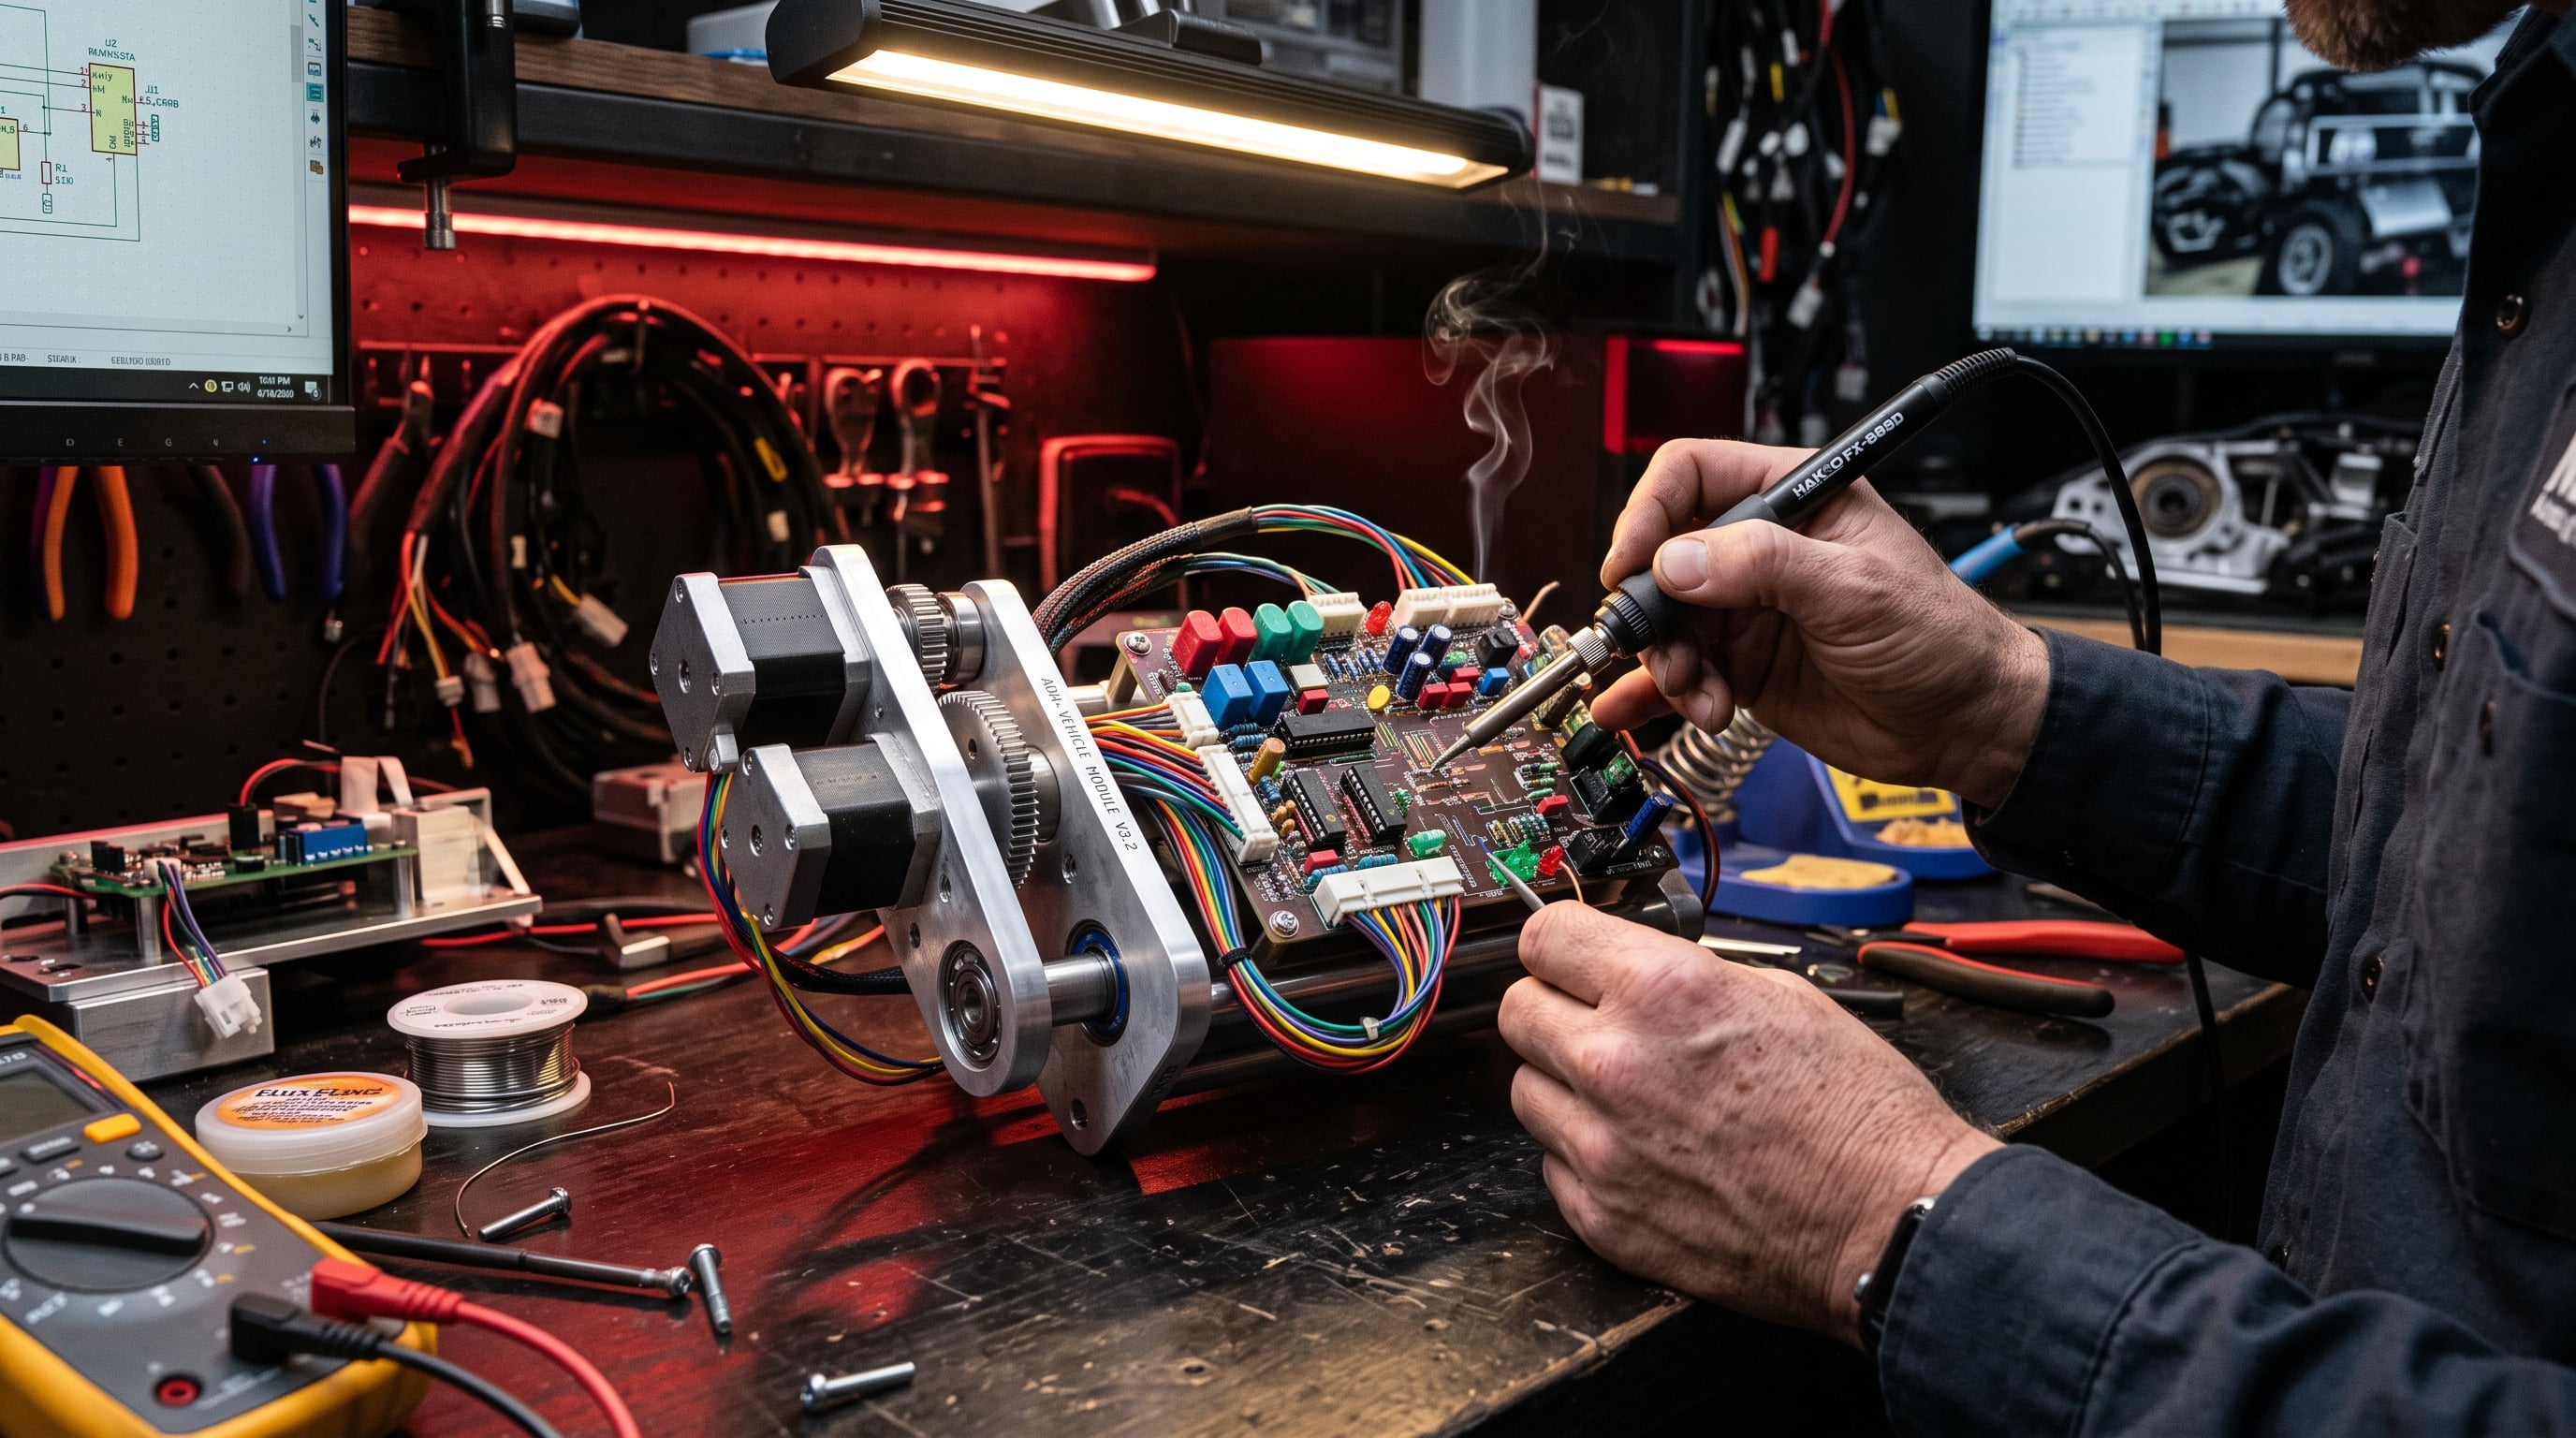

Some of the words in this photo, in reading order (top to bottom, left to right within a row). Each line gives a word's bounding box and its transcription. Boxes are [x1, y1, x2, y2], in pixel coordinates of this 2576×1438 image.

[277, 376, 291, 386] PM
[1059, 711, 1092, 759] VEHICLE
[1085, 766, 1120, 814] MODULE
